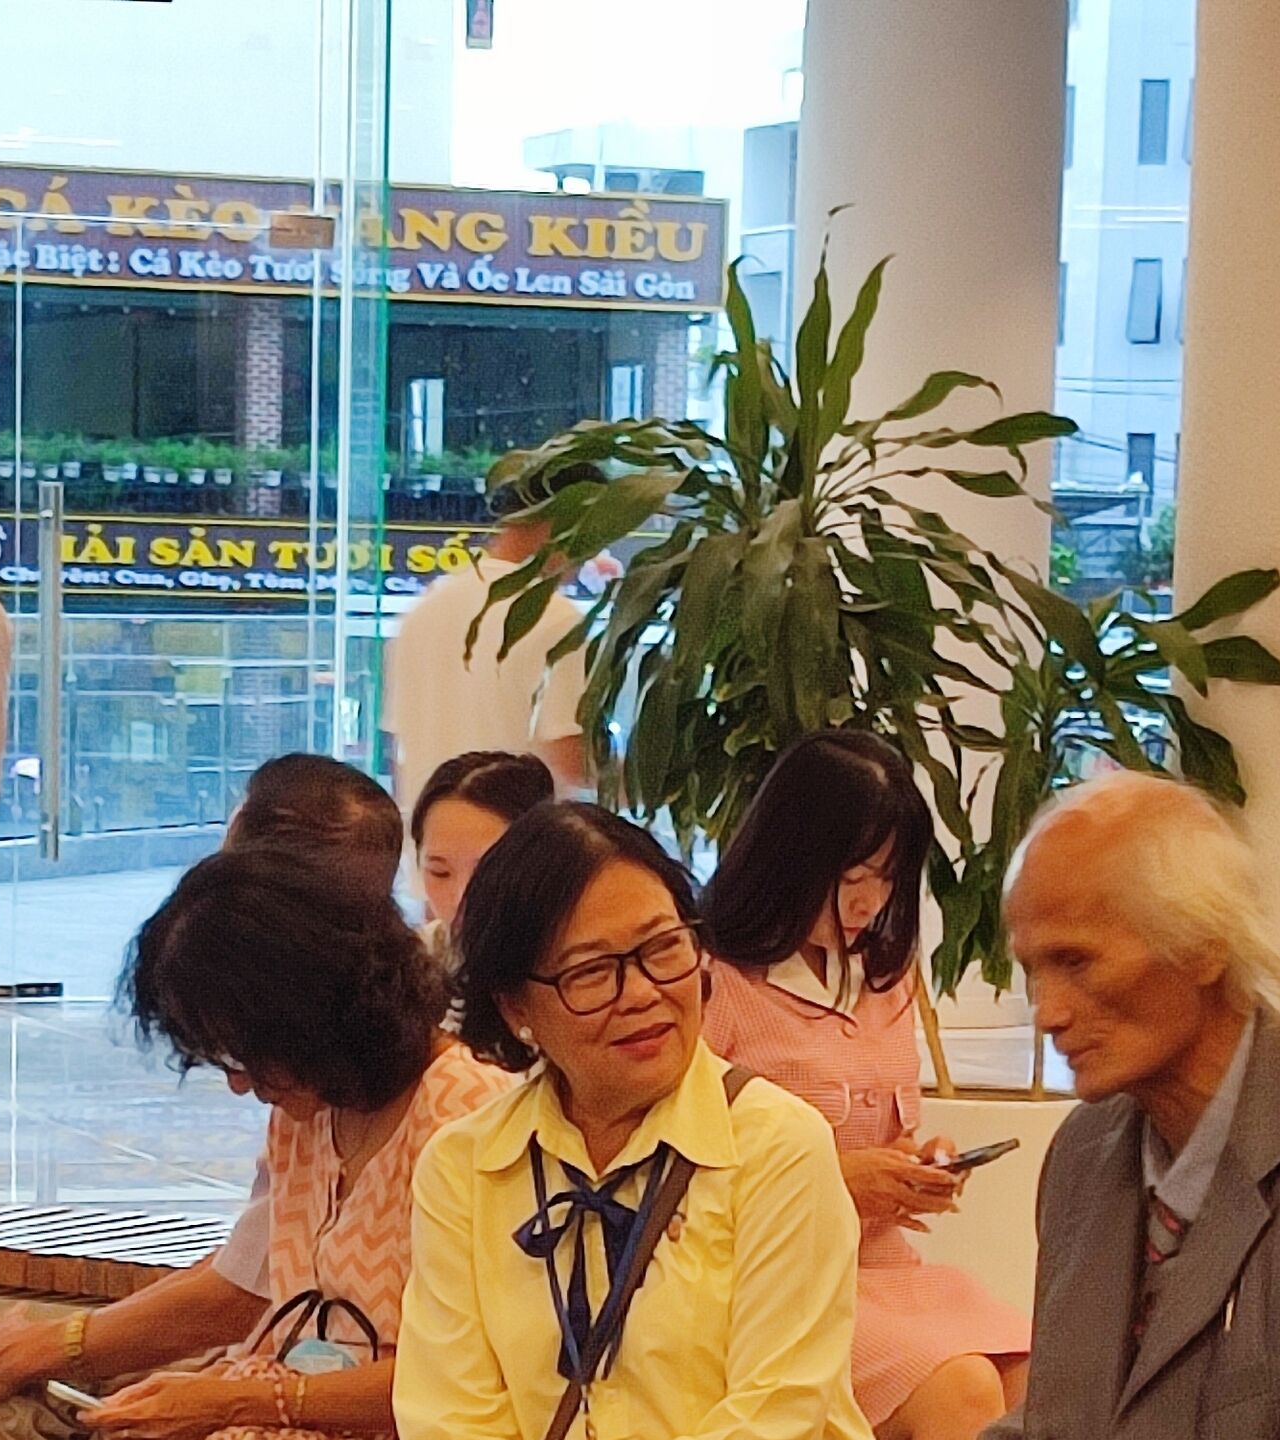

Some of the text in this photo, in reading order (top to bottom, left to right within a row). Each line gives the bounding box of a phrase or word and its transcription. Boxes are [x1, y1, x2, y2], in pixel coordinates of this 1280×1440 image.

[106, 184, 261, 241] KÈO
[526, 199, 709, 262] KIỀU
[128, 247, 172, 276] Cá
[177, 249, 243, 280] Kèo
[417, 261, 460, 290] Và
[468, 253, 510, 293] Ốc
[515, 266, 572, 295] Len
[578, 269, 627, 298] Sài
[634, 271, 696, 300] Gòn
[149, 526, 256, 569] SẢN
